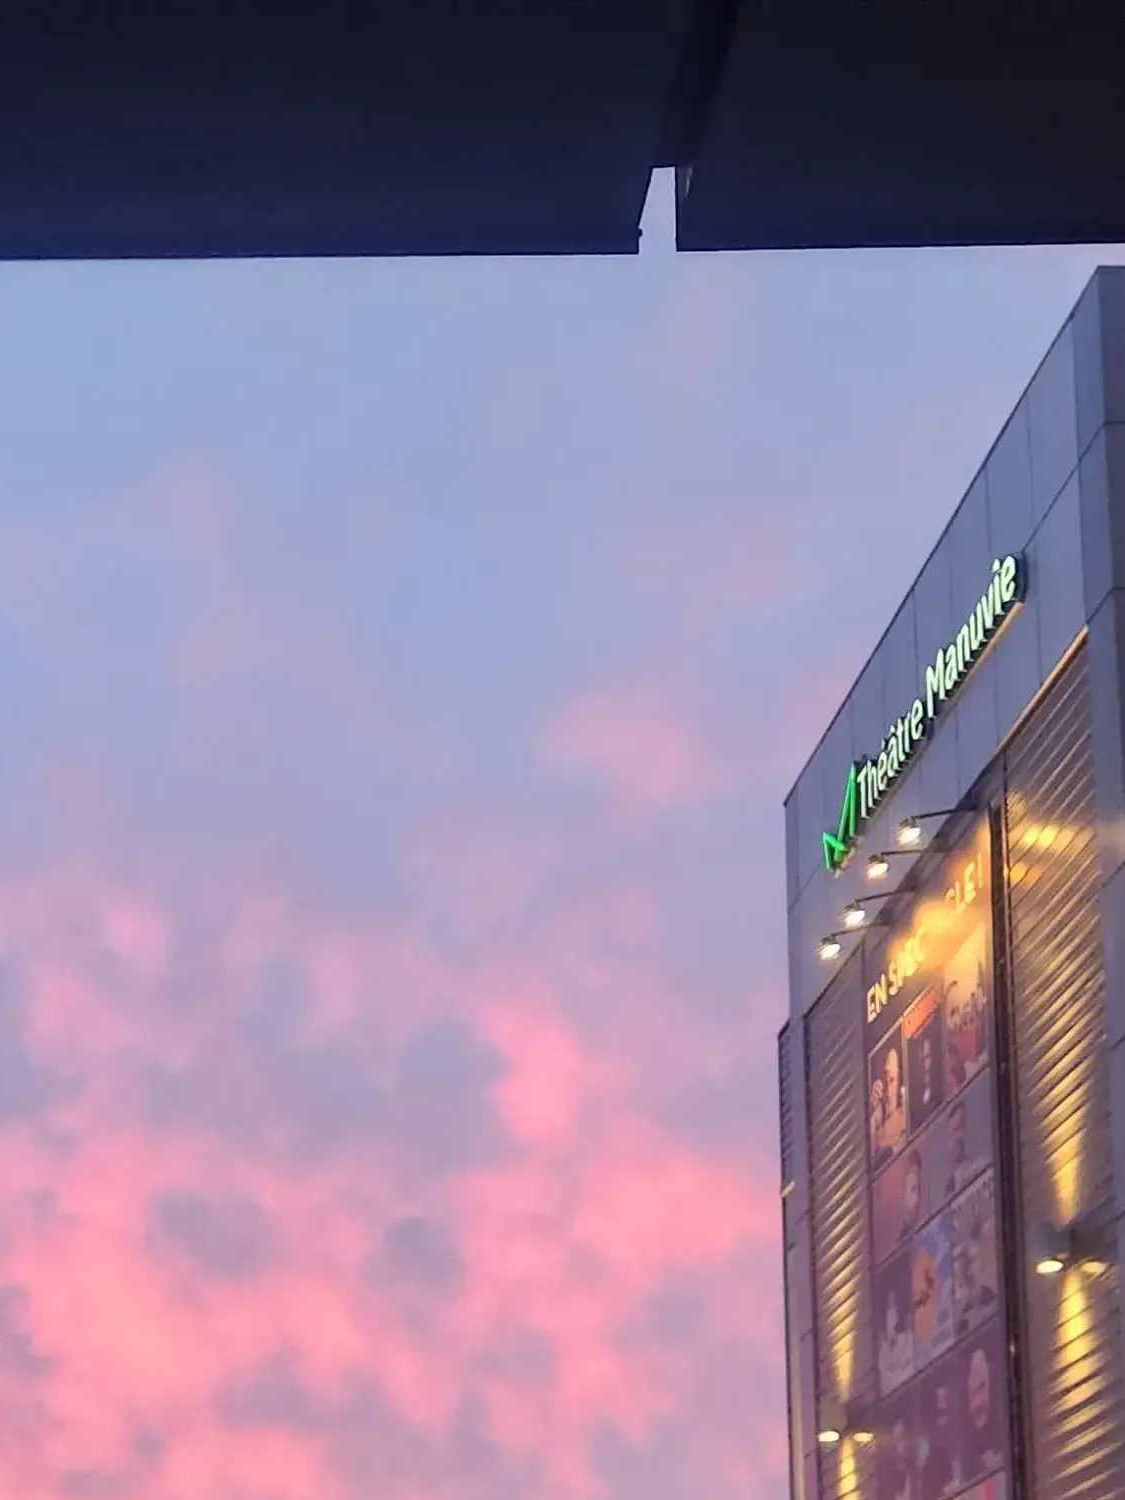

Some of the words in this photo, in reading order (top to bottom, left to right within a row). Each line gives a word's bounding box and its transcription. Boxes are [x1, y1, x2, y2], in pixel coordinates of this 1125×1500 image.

[857, 699, 923, 820] Théâtre
[926, 555, 1017, 719] Manuvie
[867, 973, 888, 1024] EN
